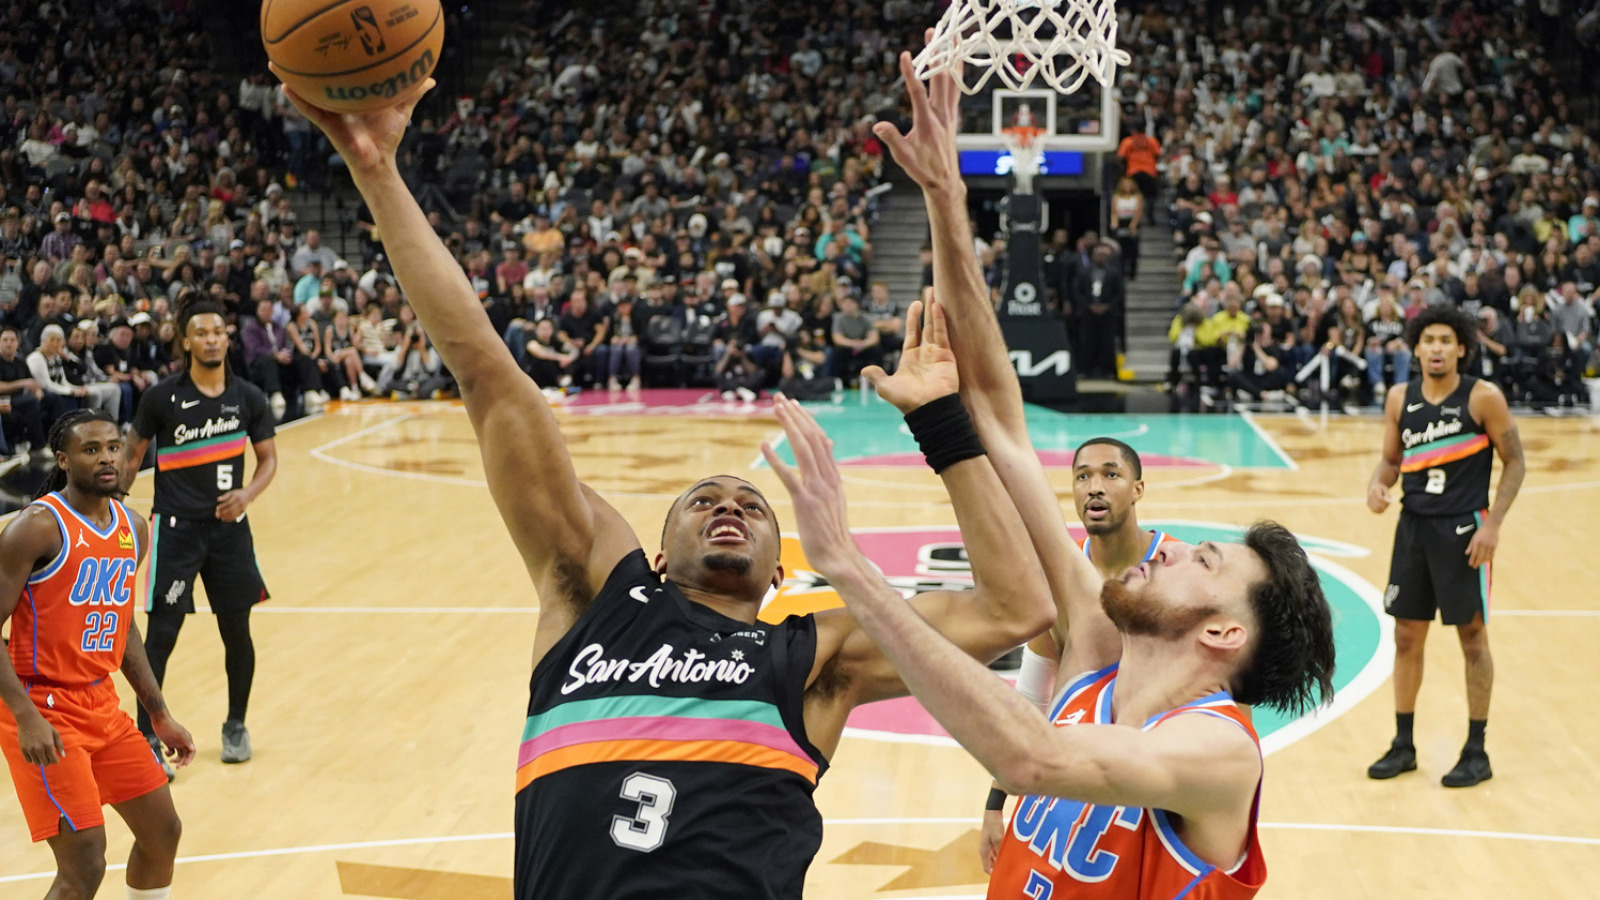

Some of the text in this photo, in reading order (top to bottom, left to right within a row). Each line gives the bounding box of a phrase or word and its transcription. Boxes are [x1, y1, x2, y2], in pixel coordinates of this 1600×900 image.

[323, 48, 434, 100] Wilson
[174, 415, 241, 446] San Antonio
[1402, 417, 1463, 449] San Antonio
[216, 464, 234, 491] 5
[1425, 468, 1447, 495] 2
[68, 556, 136, 607] OKC
[81, 611, 119, 652] 22
[560, 643, 756, 696] San Antonio
[609, 771, 678, 854] 3
